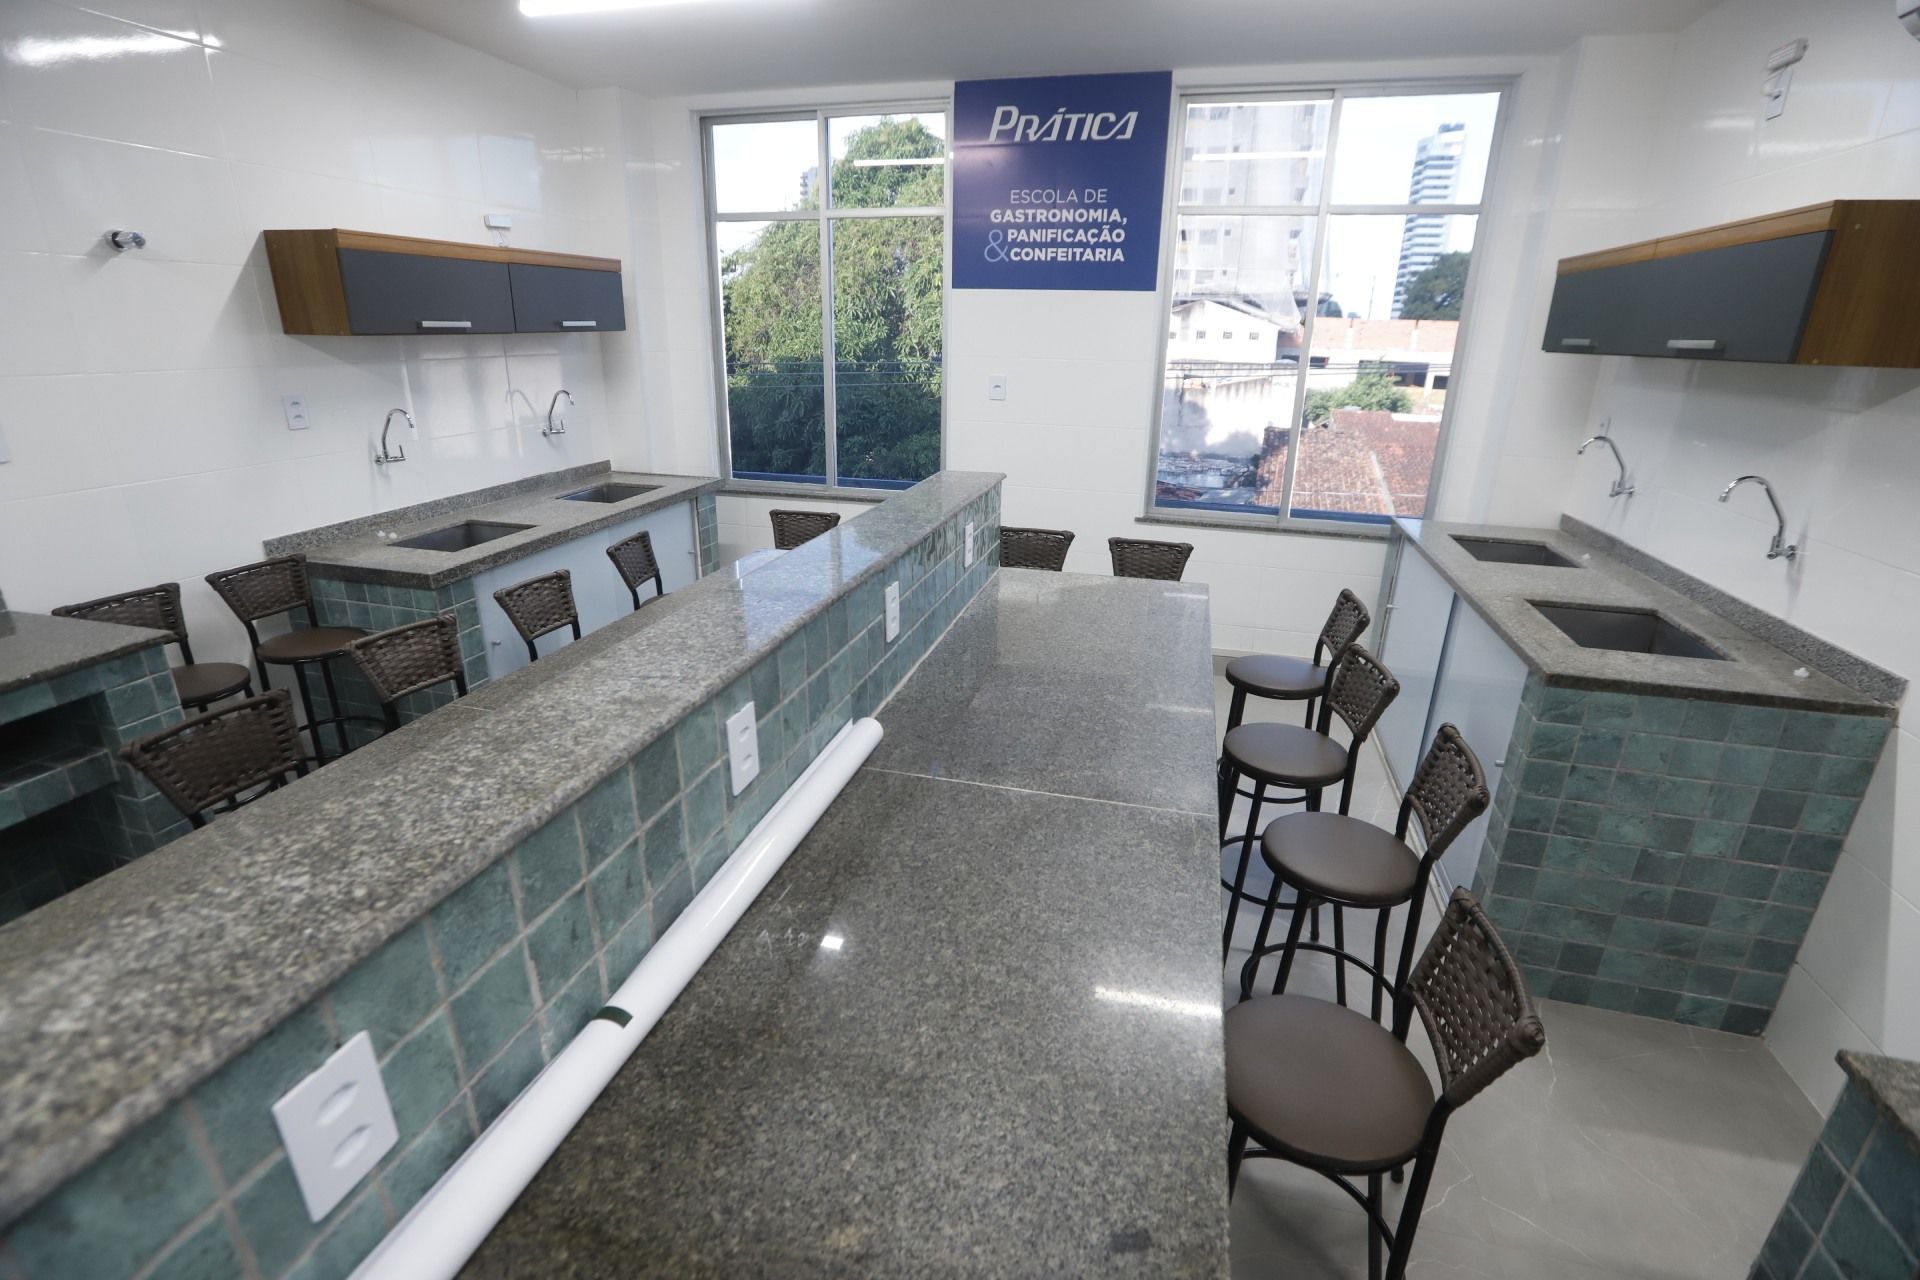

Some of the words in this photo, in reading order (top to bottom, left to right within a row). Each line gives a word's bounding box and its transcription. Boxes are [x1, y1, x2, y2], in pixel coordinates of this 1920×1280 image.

[988, 105, 1139, 144] PRÁTICA
[1010, 189, 1078, 204] ESCOLA
[1084, 188, 1108, 204] DE
[990, 208, 1128, 225] GASTRONOMIA,
[1007, 225, 1126, 245] PANIFICAÇÃO
[984, 229, 1009, 263] &
[1010, 247, 1125, 262] CONFEITARIA
